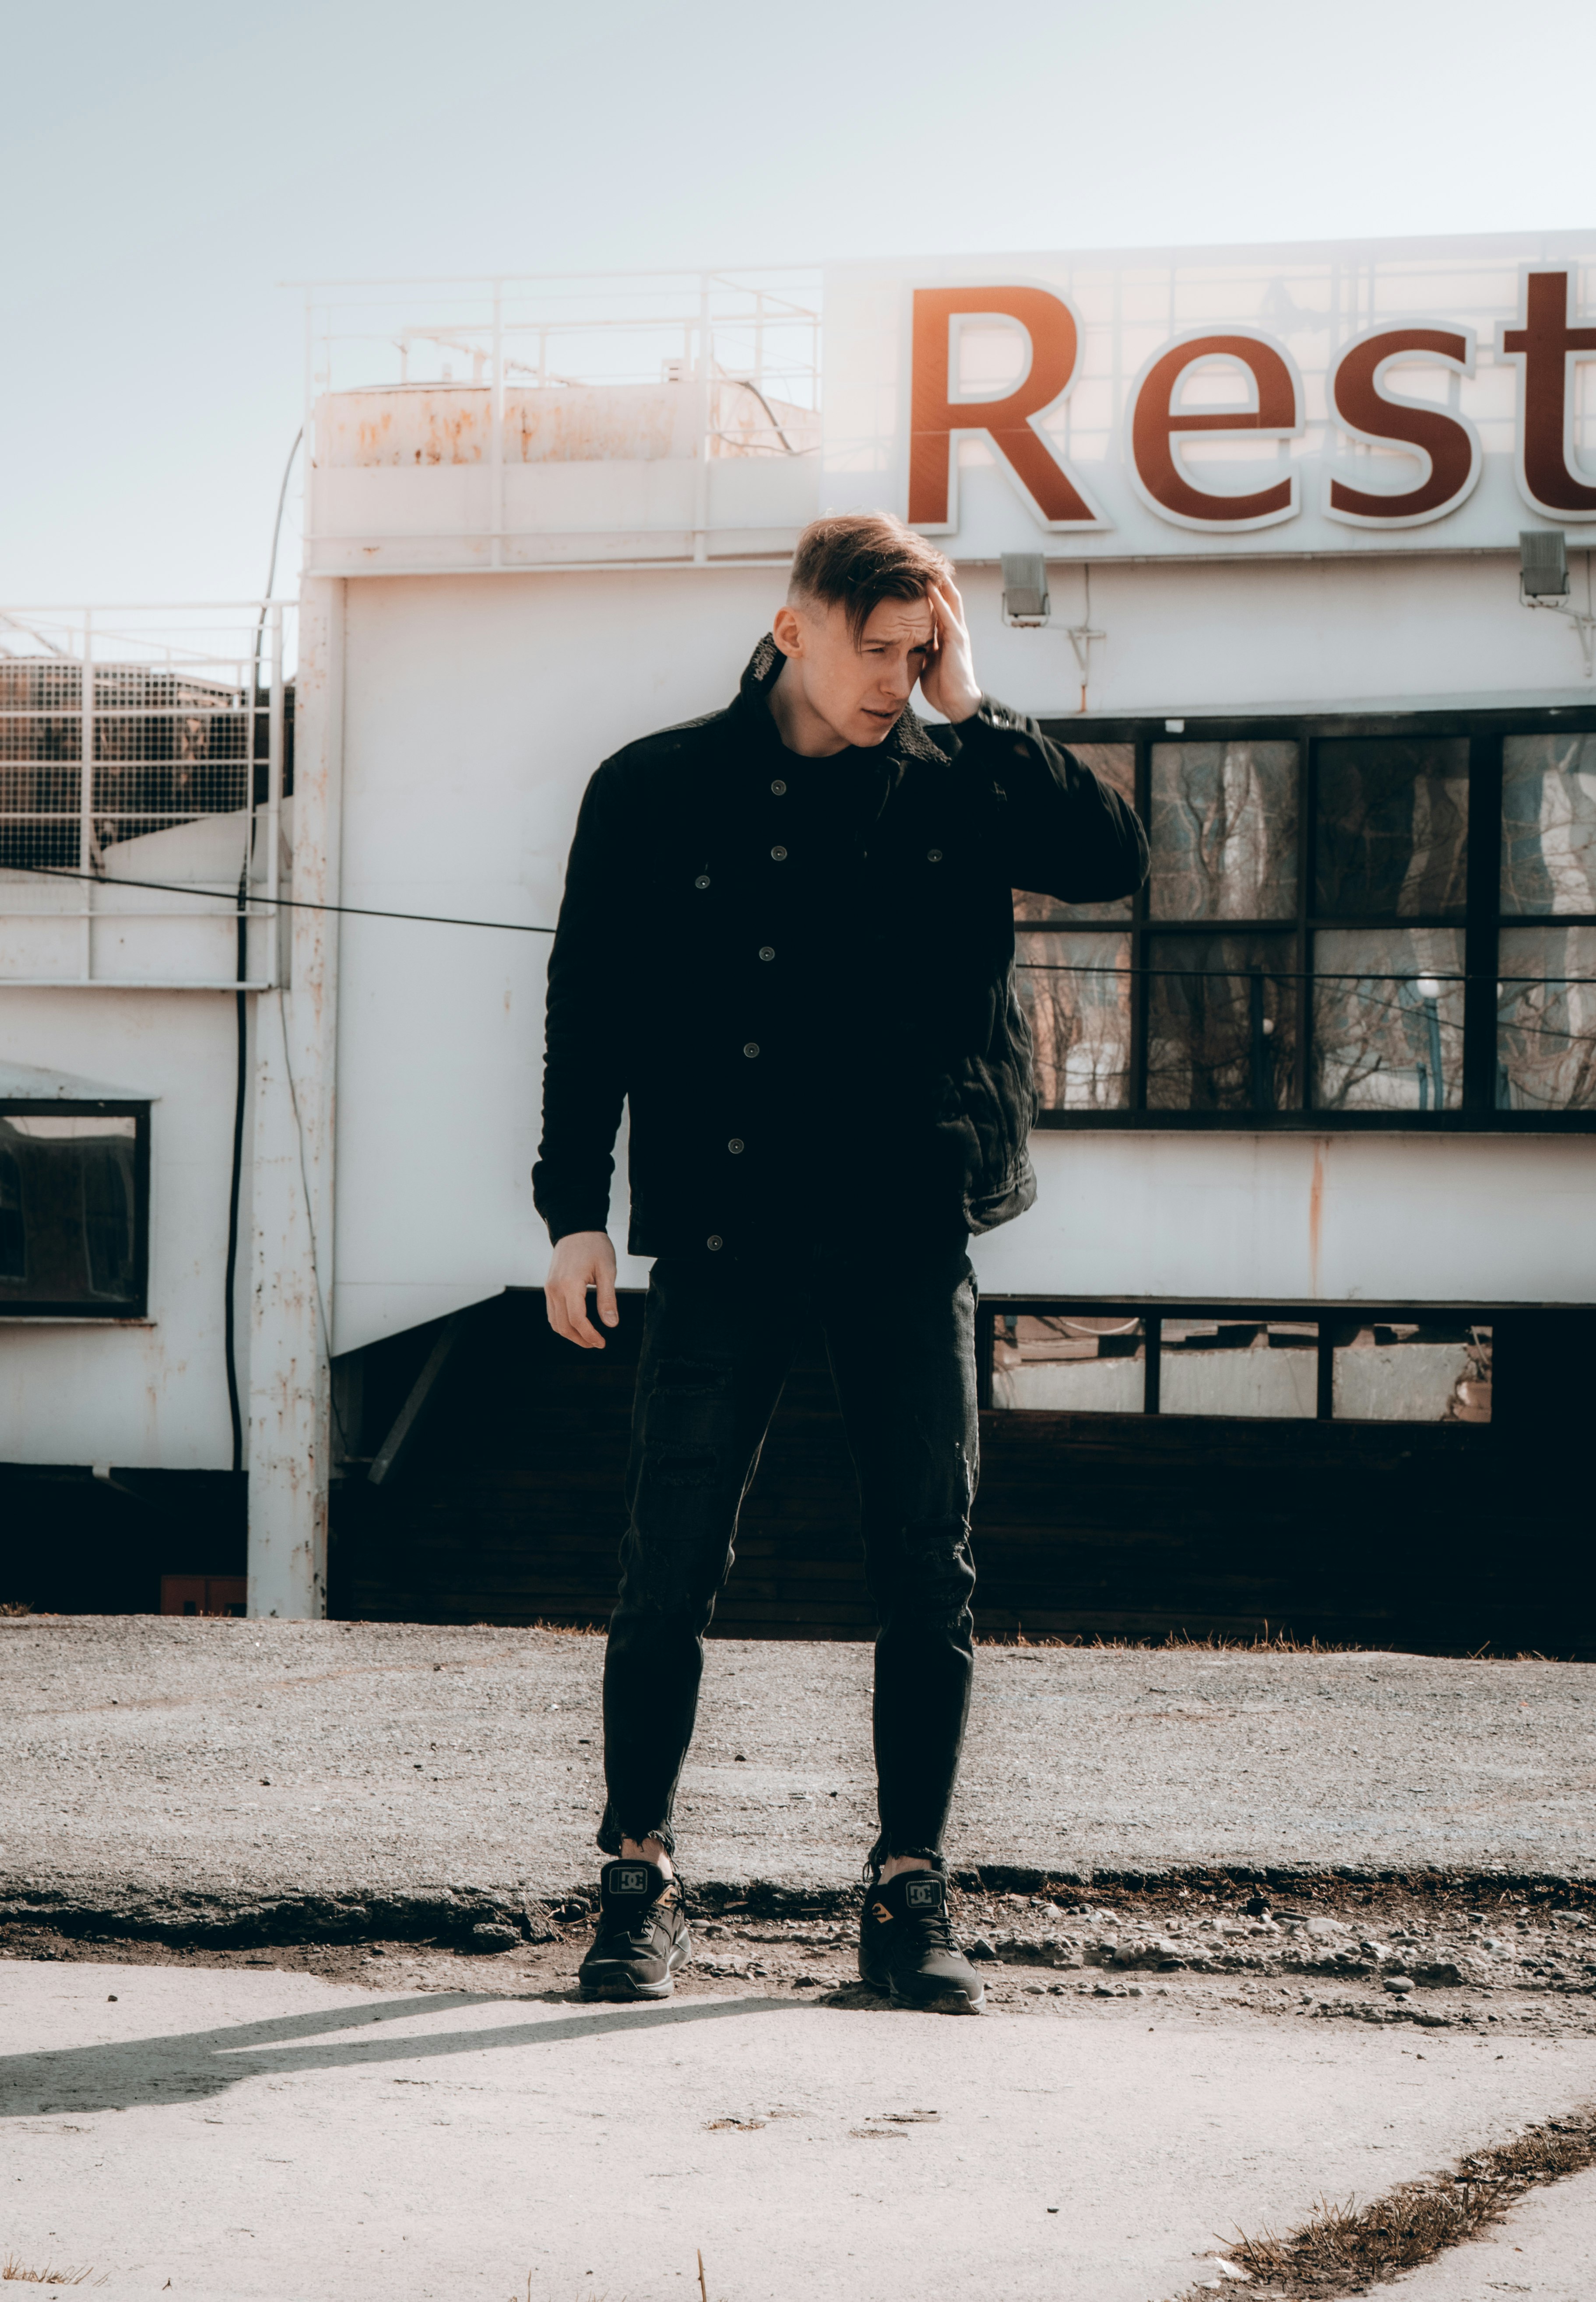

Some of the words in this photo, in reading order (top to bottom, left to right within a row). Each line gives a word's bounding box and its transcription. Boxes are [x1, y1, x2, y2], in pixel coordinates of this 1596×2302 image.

[905, 271, 1596, 525] Rest
[622, 1871, 643, 1889] DC
[910, 1885, 932, 1904] DC
